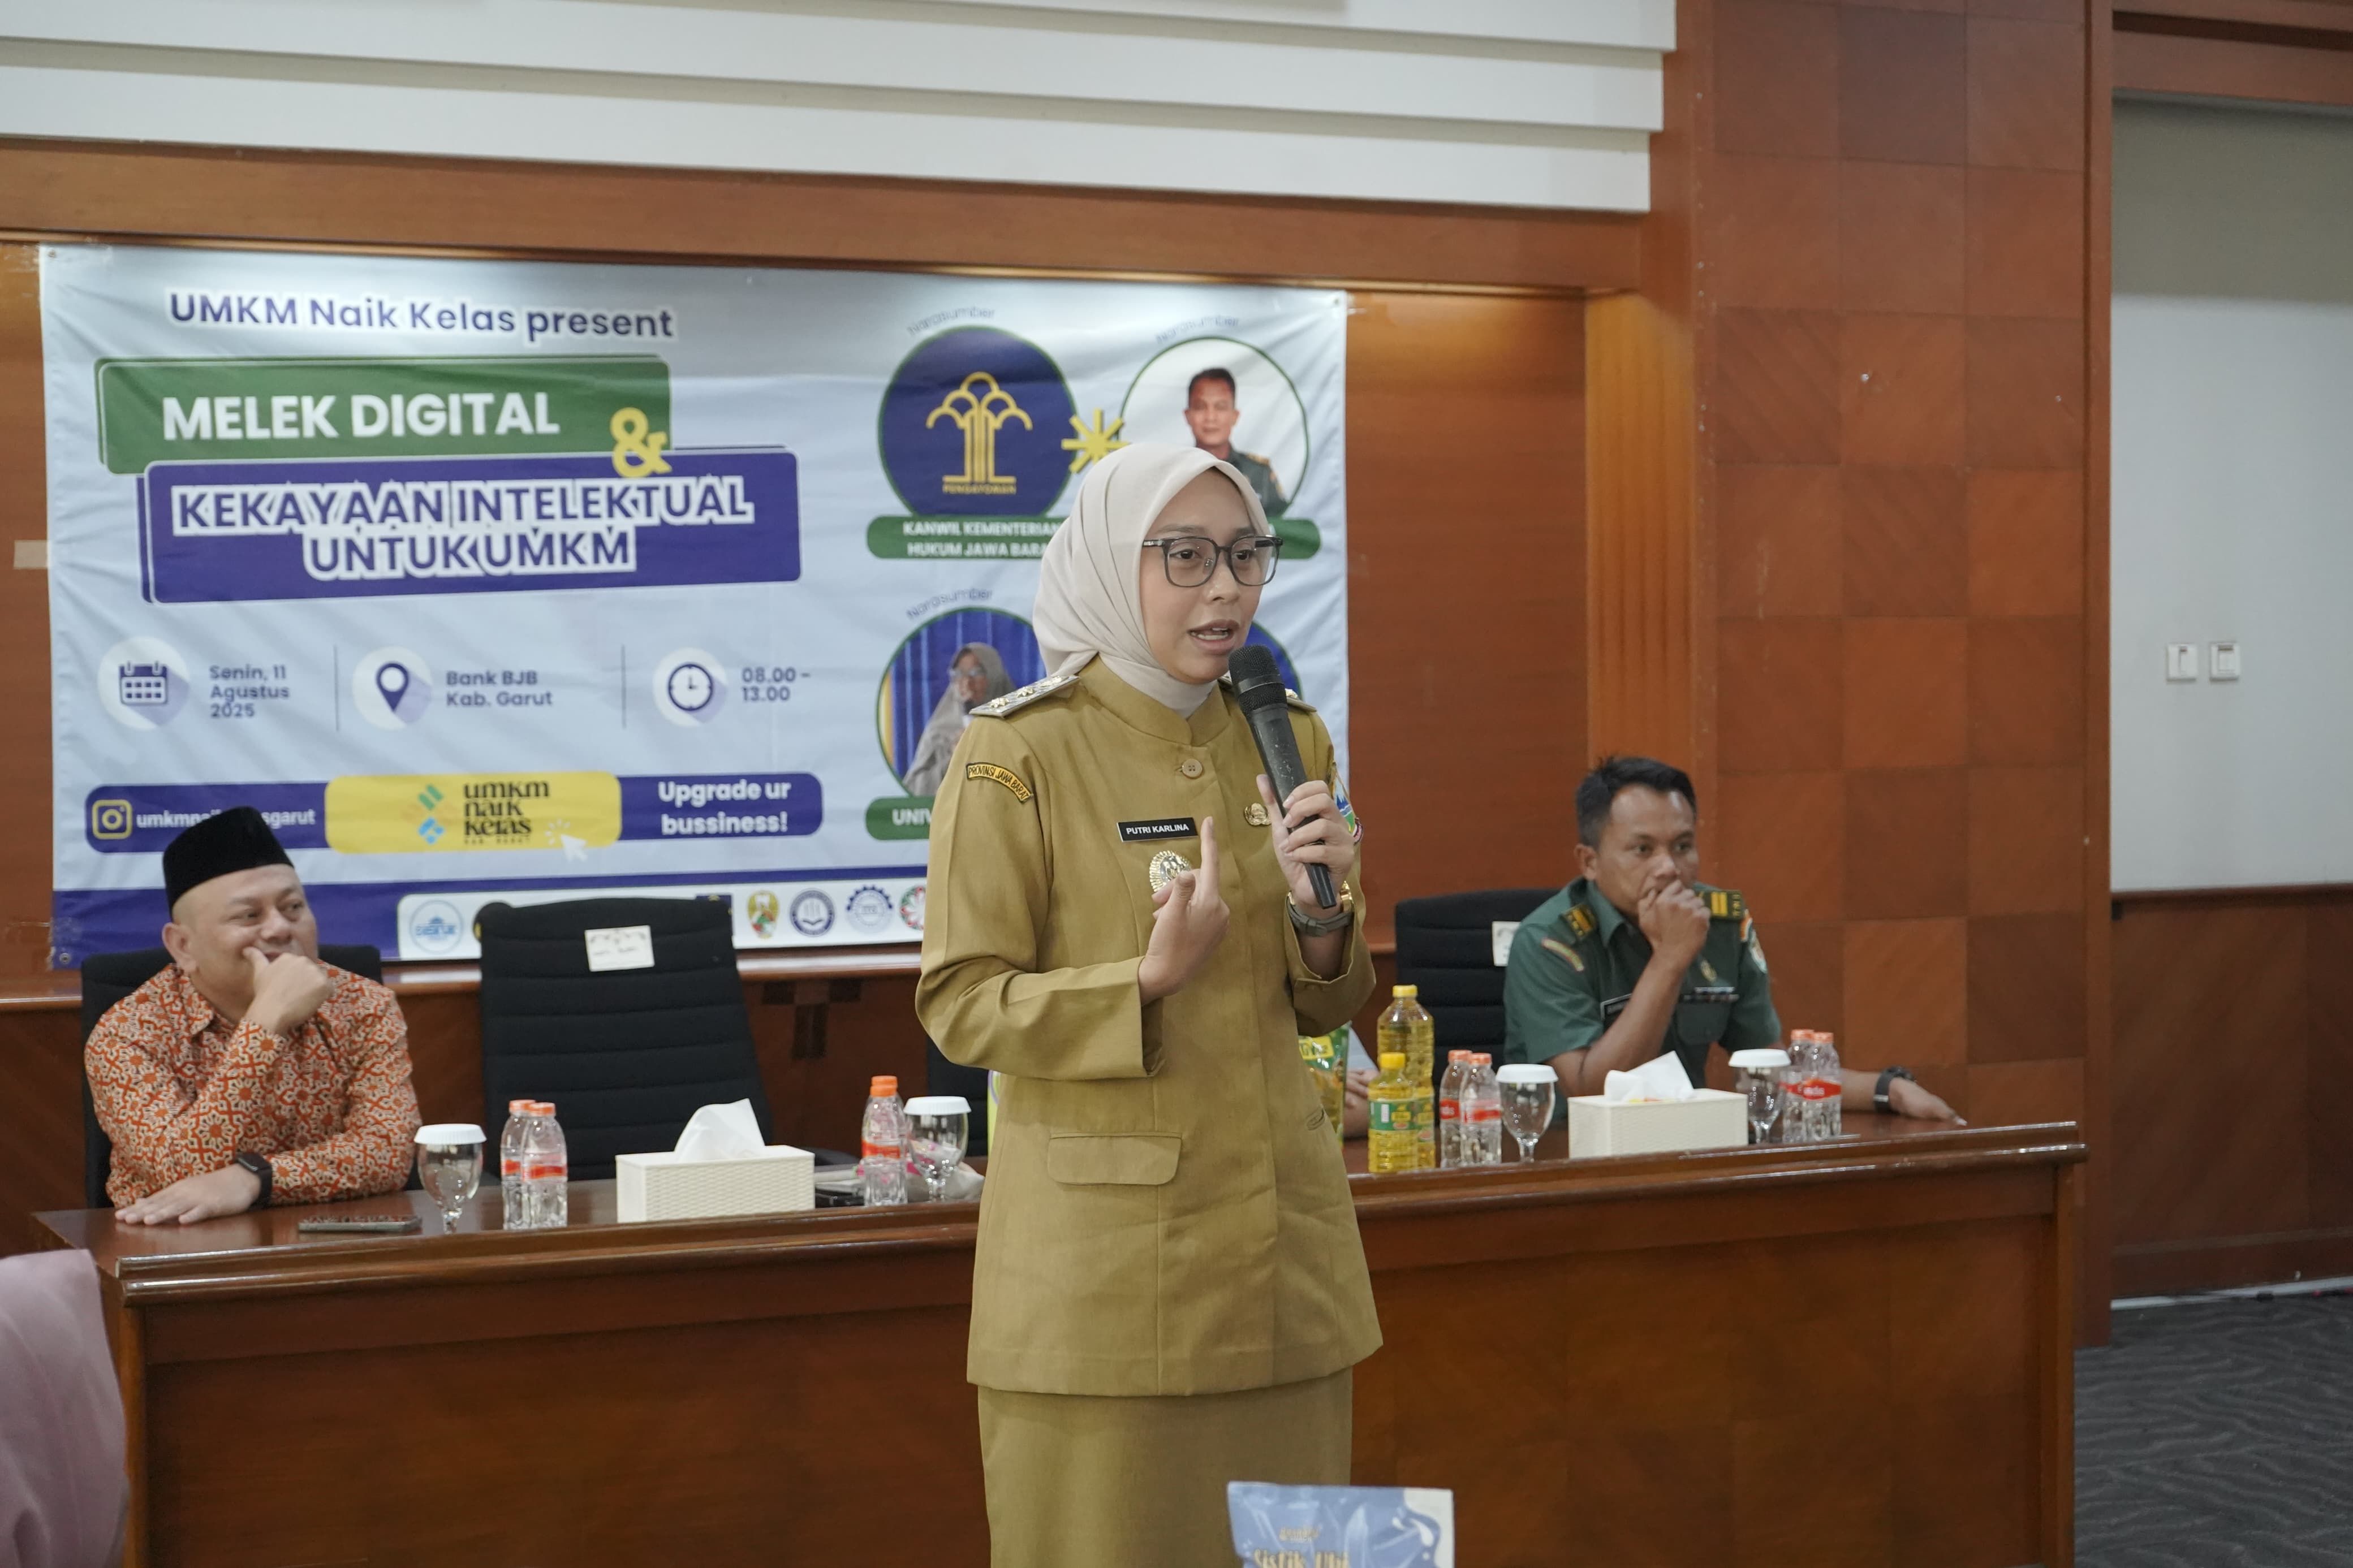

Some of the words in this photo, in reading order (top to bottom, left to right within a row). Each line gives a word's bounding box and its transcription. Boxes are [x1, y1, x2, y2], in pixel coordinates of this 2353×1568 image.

[171, 293, 298, 325] UMKM
[311, 297, 398, 329] Naik
[411, 303, 516, 332] Kelas
[527, 309, 674, 342] present
[162, 395, 339, 441] MELEK
[350, 392, 561, 439] DIGITAL
[610, 407, 673, 478] &
[178, 487, 444, 530] KEKAYAAN
[458, 482, 748, 523] INTELEKTUAL
[903, 521, 962, 535] KANWIL
[310, 533, 474, 573] UNTUK
[485, 530, 630, 569] UMKM
[907, 542, 962, 557] HUKUM
[964, 542, 1009, 557] JAWA
[209, 663, 268, 682] Senin,
[273, 664, 286, 680] 11
[447, 670, 497, 686] Bank
[502, 669, 537, 686] BJB
[742, 667, 796, 683] 08.00
[210, 684, 290, 702] Agustus
[447, 690, 492, 707] Kab.
[496, 690, 553, 706] Garut
[742, 686, 791, 702] 13.00
[210, 702, 255, 718] 2025
[464, 780, 550, 799] umkm
[968, 765, 996, 778] PROVINSI
[995, 770, 1013, 785] JAWA
[1010, 779, 1029, 800] BARAT
[658, 779, 762, 808] Upgrade
[764, 782, 792, 800] ur
[661, 811, 788, 835] bussiness!
[1126, 827, 1152, 835] PUTRI
[1152, 823, 1190, 833] KARLINA
